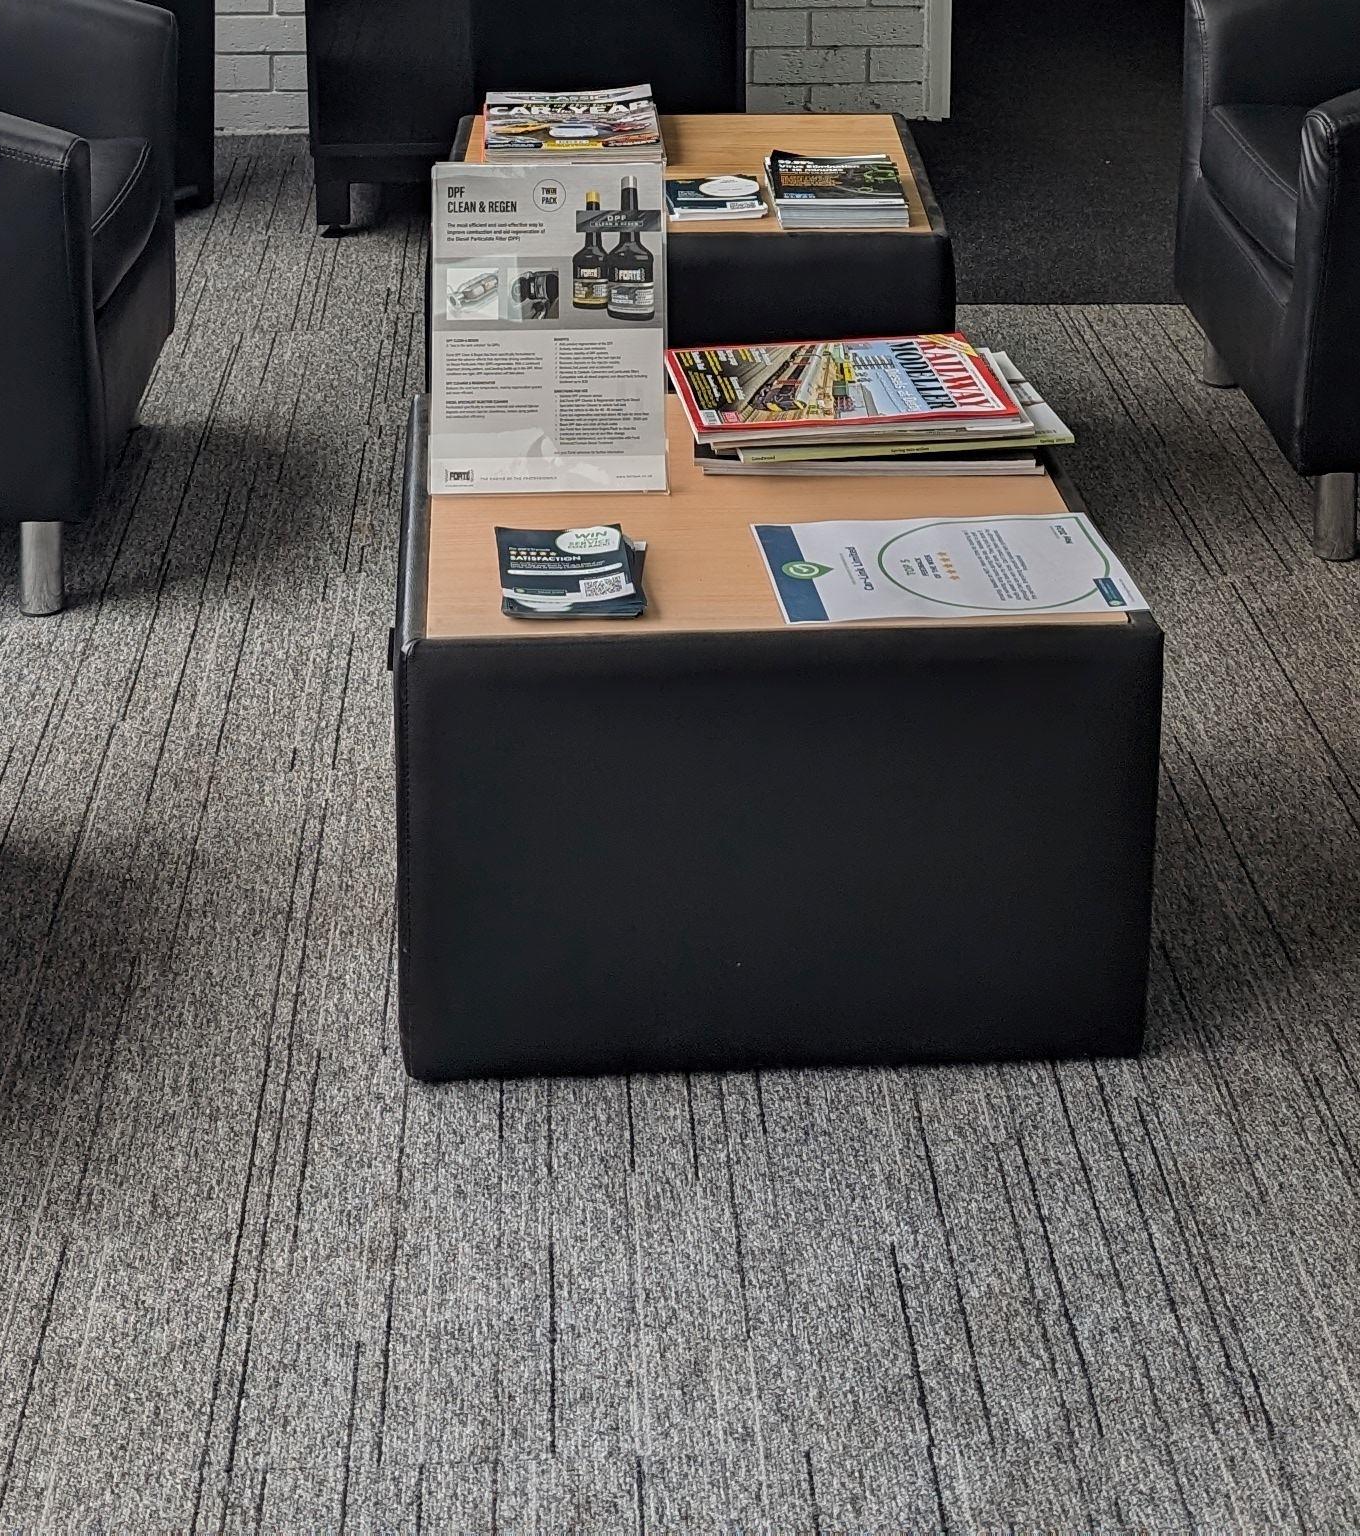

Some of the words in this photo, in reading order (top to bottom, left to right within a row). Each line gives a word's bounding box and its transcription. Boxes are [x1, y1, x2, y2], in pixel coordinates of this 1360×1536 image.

[529, 94, 610, 102] CLASSIC
[490, 106, 546, 115] CAR
[570, 100, 650, 115] YEAR
[447, 186, 465, 199] DPF
[541, 187, 557, 195] TWIN
[447, 201, 476, 213] CLEAN
[478, 201, 486, 213] &
[488, 201, 517, 213] REGEN
[541, 197, 558, 205] PACK
[890, 341, 958, 410] MODELLER
[915, 340, 996, 409] RAILWAY
[574, 530, 608, 540] WIN
[844, 546, 863, 566] Limited
[855, 567, 874, 591] Car-Link
